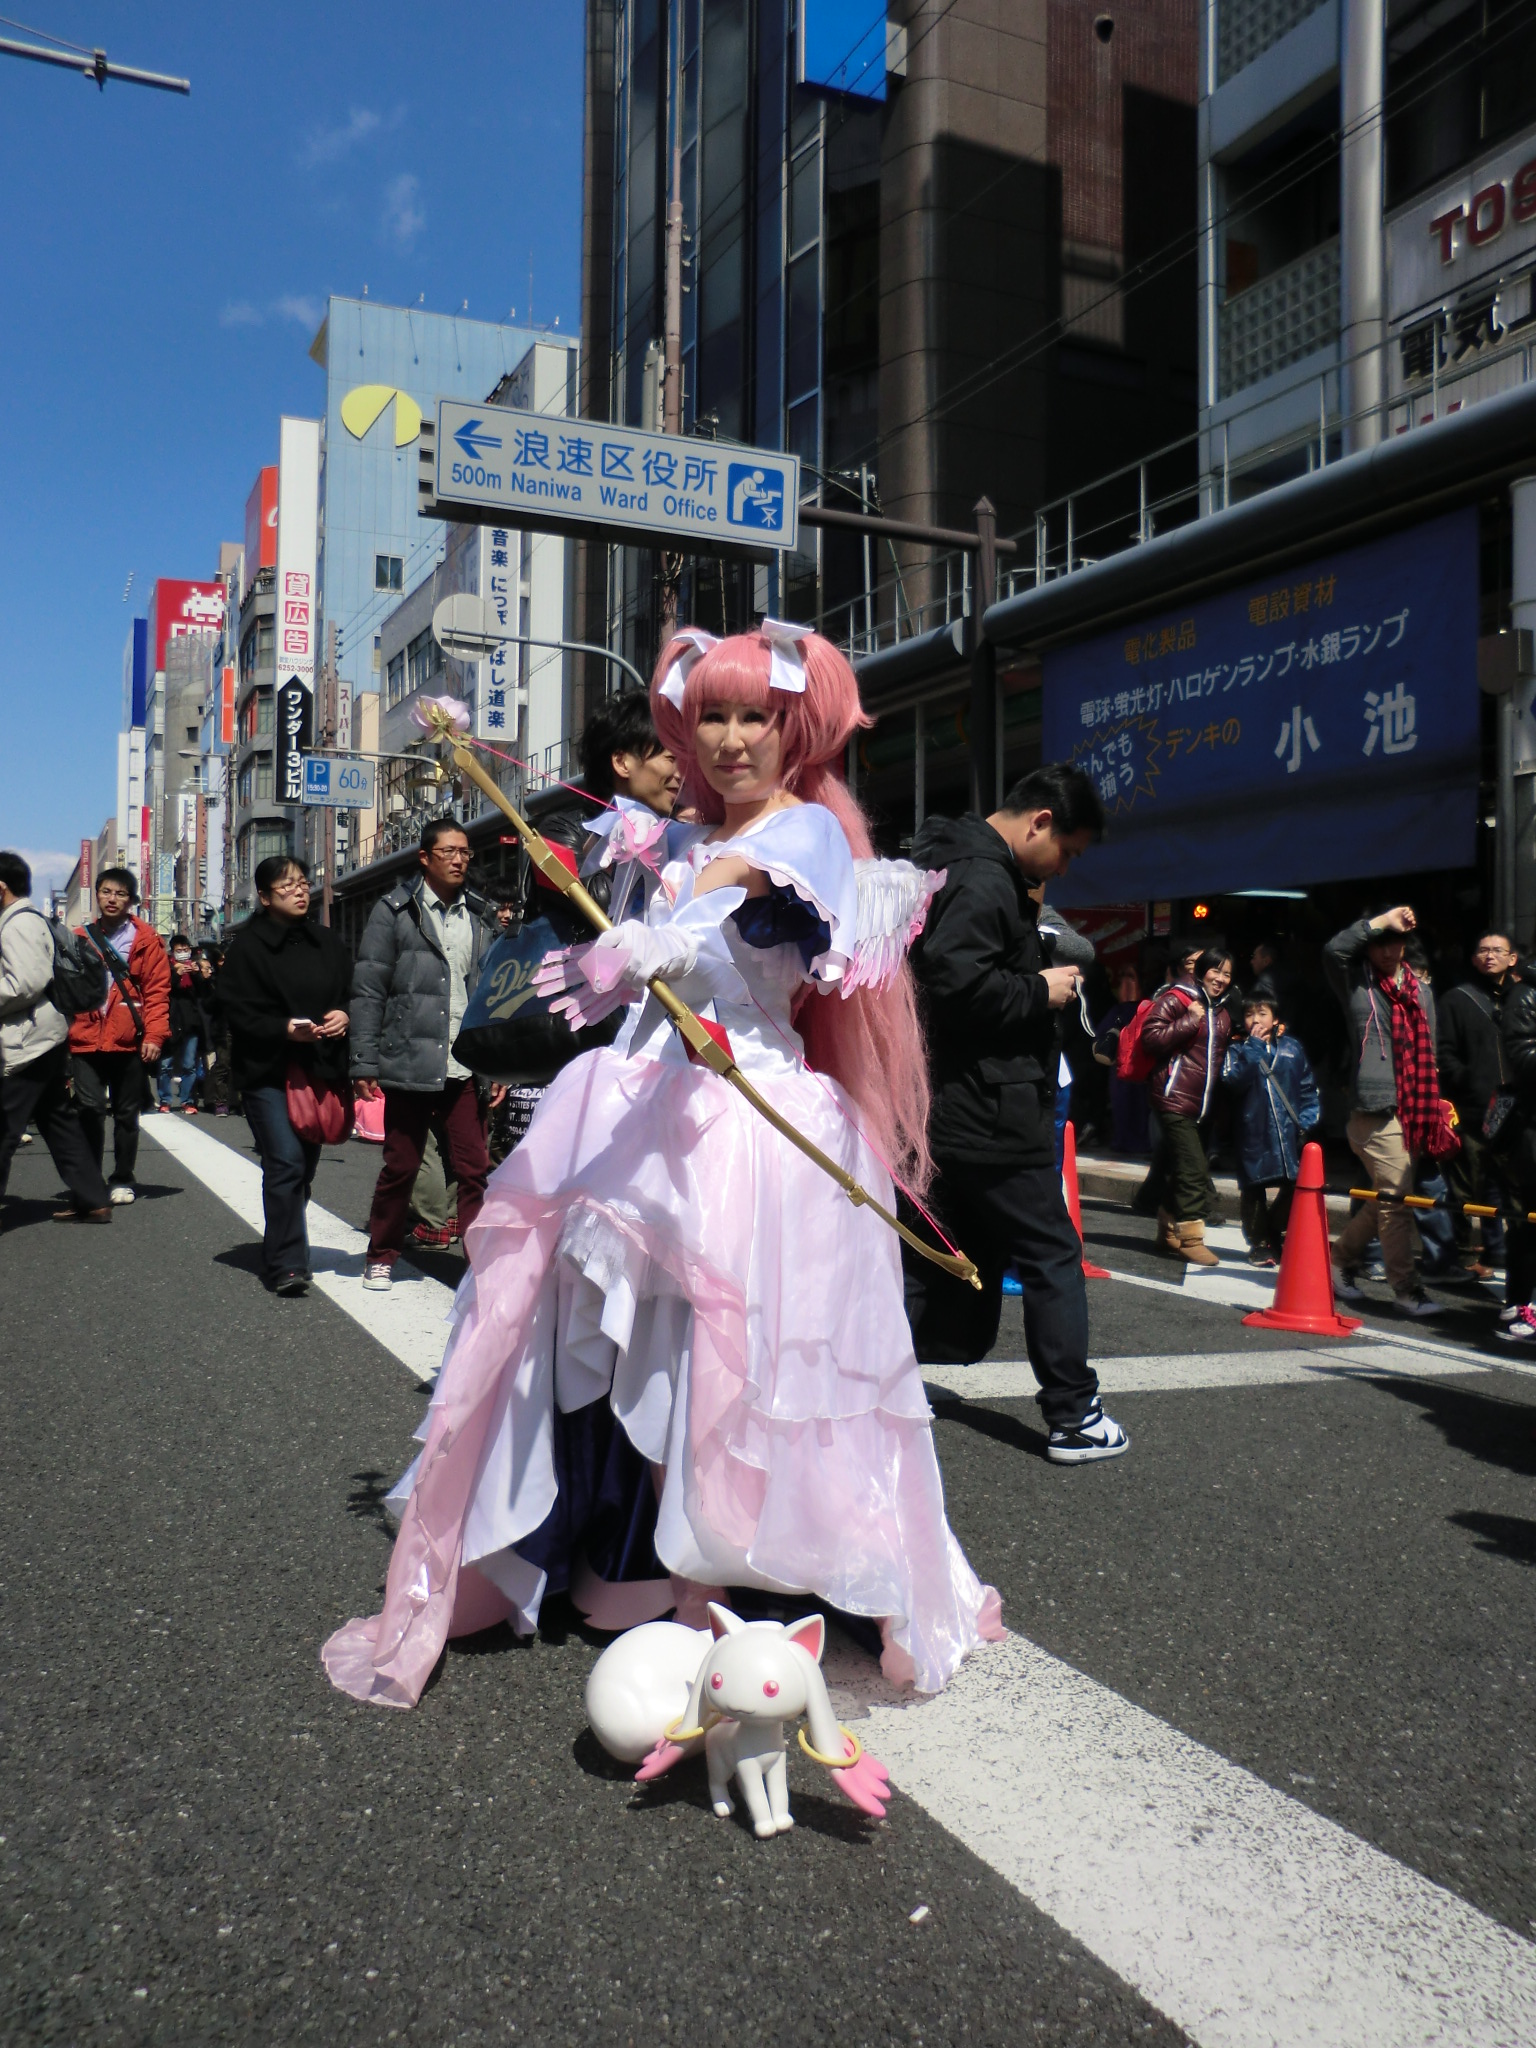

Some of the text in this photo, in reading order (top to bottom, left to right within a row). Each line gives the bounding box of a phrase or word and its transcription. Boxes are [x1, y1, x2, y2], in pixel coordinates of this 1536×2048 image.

[513, 429, 719, 497] 浪速区役所
[451, 463, 718, 523] 500m Naniwa Ward Office
[490, 529, 509, 568] 音楽
[284, 572, 311, 655] 貸広告
[1248, 573, 1337, 628] 電設資材
[1123, 619, 1198, 666] 電化製品
[278, 664, 314, 674] 6252-3000
[285, 690, 303, 800] ワンダー3ビル
[338, 689, 350, 750] スーパー
[1165, 717, 1241, 760] デンキの
[313, 763, 326, 782] P
[338, 768, 368, 791] 60分
